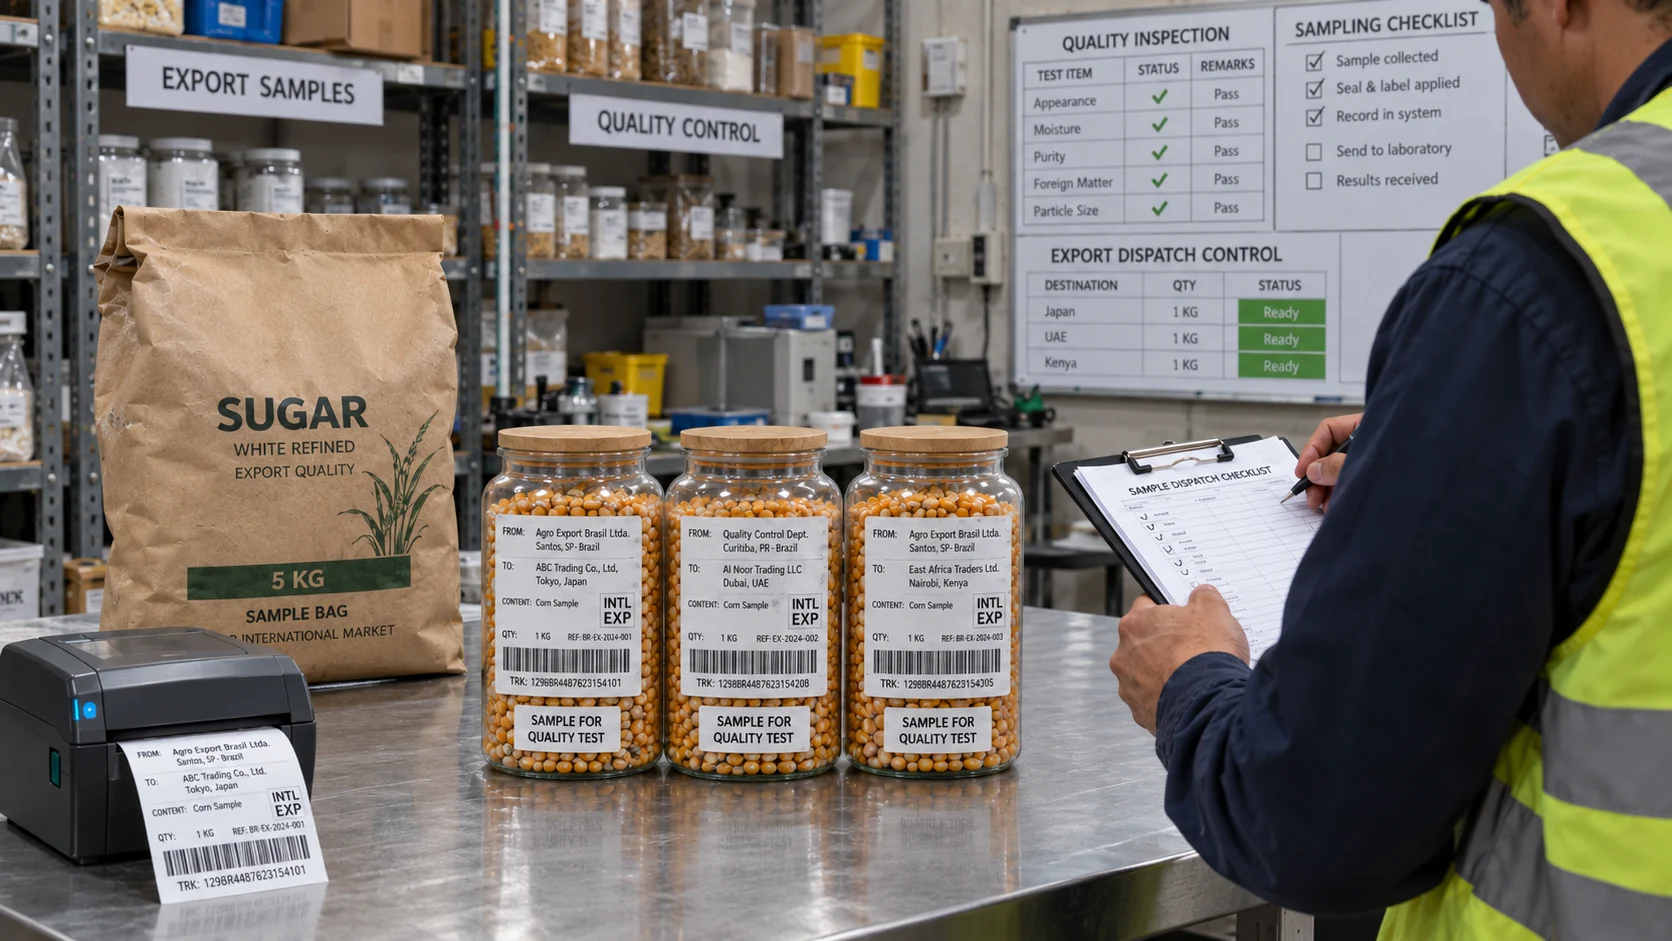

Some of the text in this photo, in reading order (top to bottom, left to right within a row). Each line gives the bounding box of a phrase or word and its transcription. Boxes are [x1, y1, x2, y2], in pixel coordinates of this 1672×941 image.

[1295, 11, 1479, 38] SAMPLING CHECKLIST
[1062, 26, 1230, 52] QUALITY INSPECTION
[1201, 58, 1255, 72] REMARKS
[1336, 50, 1438, 69] Sample collected
[1038, 68, 1092, 81] TEST ITEM
[1138, 63, 1179, 75] STATUS
[162, 66, 355, 105] EXPORT SAMPLES
[1336, 76, 1460, 95] Seal & label applied
[1214, 88, 1239, 100] Pass
[1033, 96, 1097, 112] Appearance
[1336, 107, 1442, 123] Record in system
[598, 110, 760, 144] QUALITY CONTROL
[1214, 117, 1239, 129] Pass
[1034, 124, 1081, 136] Moisture
[1214, 145, 1239, 157] Pass
[1336, 143, 1452, 157] Send to laboratory
[1034, 151, 1066, 165] Purity
[1034, 177, 1113, 192] Foreign Matter
[1214, 174, 1239, 185] Pass
[1336, 172, 1438, 186] Results received
[1034, 205, 1098, 218] Particle Size
[1214, 202, 1239, 214] Pass
[1051, 246, 1282, 263] EXPORT DISPATCH CONTROL
[1045, 280, 1118, 291] DESTINATION
[1173, 280, 1196, 293] QTY
[1259, 280, 1301, 291] STATUS
[1045, 306, 1075, 319] Japan
[1183, 307, 1198, 317] KG
[1264, 307, 1299, 321] Ready
[1045, 332, 1067, 343] UAE
[1183, 333, 1198, 344] KG
[1264, 333, 1299, 347] Ready
[1045, 357, 1077, 371] Kenya
[1183, 359, 1198, 371] KG
[1264, 360, 1299, 374] Ready
[217, 396, 368, 432] SUGAR
[234, 440, 355, 456] WHITE REFINED
[235, 464, 355, 480] EXPORT QUALITY
[1128, 466, 1272, 496] SAMPLE DISPATCH CHECKLIST
[503, 527, 630, 539] FROM: Agro Export Brasil Ltda.
[689, 529, 808, 540] FROM: Quality Control Dept.
[873, 529, 1001, 540] FROM: Agro Export Brasil Ltda.
[536, 542, 600, 551] Santos, Brazil
[776, 544, 798, 553] Brazil
[909, 543, 975, 553] Santos, Brazil
[503, 562, 600, 574] TO: ABC Trading Co.,
[689, 565, 802, 576] TO: Noor Trading LLC
[873, 564, 999, 574] TO: East Africa Traders Ltd.
[272, 570, 324, 590] 5 KG
[536, 577, 587, 587] Tokyo, Japan
[723, 579, 769, 588] Dubai, UAE
[909, 579, 968, 589] Nairobi, Kenya
[502, 598, 579, 608] CONTENT: Corn Sample
[604, 597, 631, 609] INTL
[688, 600, 768, 610] CONTENT: Corn Sample
[792, 598, 819, 609] INTL
[872, 601, 953, 610] CONTENT: Corn Sample
[977, 597, 1003, 609] INTL
[246, 604, 348, 623] SAMPLE BAG
[604, 612, 631, 624] EXP
[792, 613, 818, 625] EXP
[977, 612, 1002, 624] EXP
[343, 624, 395, 640] MARKET
[502, 630, 551, 640] QTY: KG
[688, 633, 771, 643] QTY: KG REF:
[873, 633, 889, 642] QTY:
[510, 677, 527, 686] TRK:
[697, 678, 715, 688] TRK:
[881, 679, 899, 688] TRK:
[531, 715, 601, 727] SAMPLE FOR
[717, 715, 791, 727] SAMPLE FOR
[902, 716, 974, 728] SAMPLE FOR
[528, 731, 605, 743] QUALITY TEST
[714, 732, 794, 744] QUALITY TEST
[899, 732, 977, 745] QUALITY TEST
[173, 742, 247, 758] Agro Export Brasil
[183, 771, 232, 783] ABC Trading
[272, 790, 299, 803] INTL
[276, 804, 301, 817] EXP
